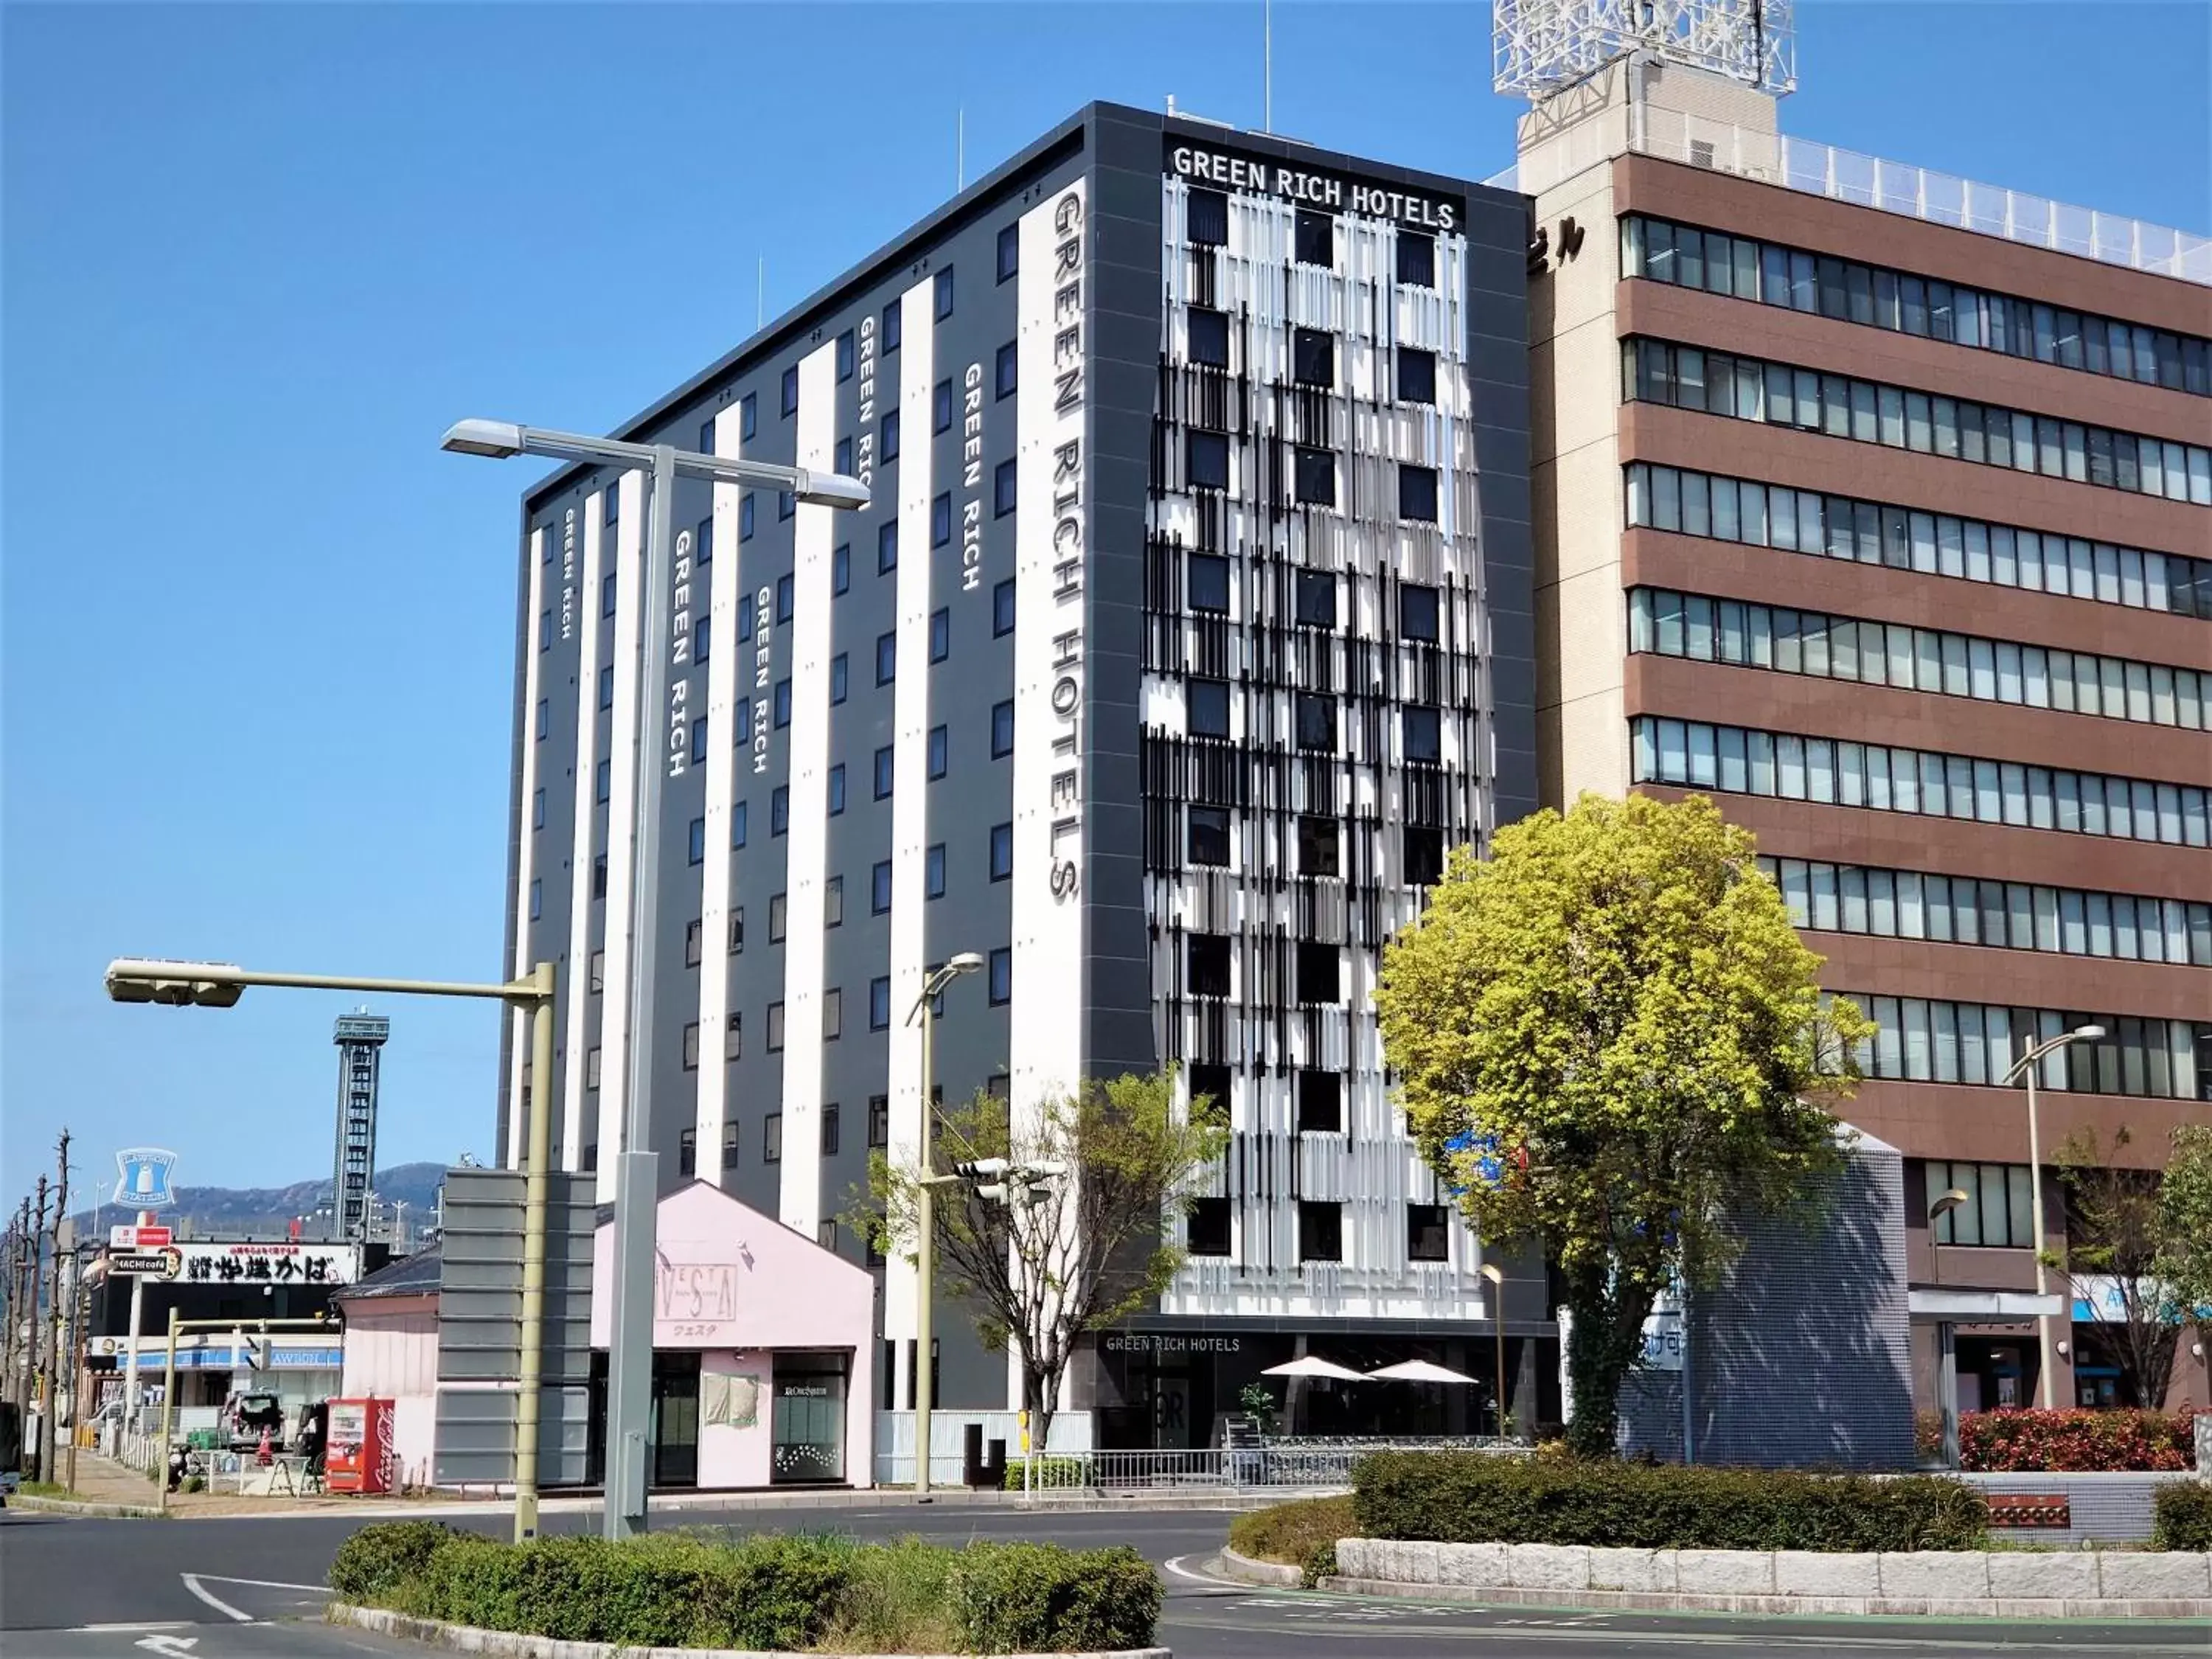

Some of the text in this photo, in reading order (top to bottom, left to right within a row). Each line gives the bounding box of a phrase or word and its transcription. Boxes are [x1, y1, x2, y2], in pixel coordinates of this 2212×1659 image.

[1173, 147, 1454, 230] GREEN RICH HOTELS
[858, 316, 874, 512] GREEN RIC
[963, 362, 981, 591] GREEN RICH
[562, 507, 575, 640] GREEN RICH
[1049, 194, 1081, 898] GREEN RICH HOTELS
[669, 530, 691, 777] GREEN RICH
[754, 585, 770, 774] GREEN RICH
[274, 1352, 320, 1363] AWSON
[1106, 1336, 1240, 1352] GREEN RICH HOTELS
